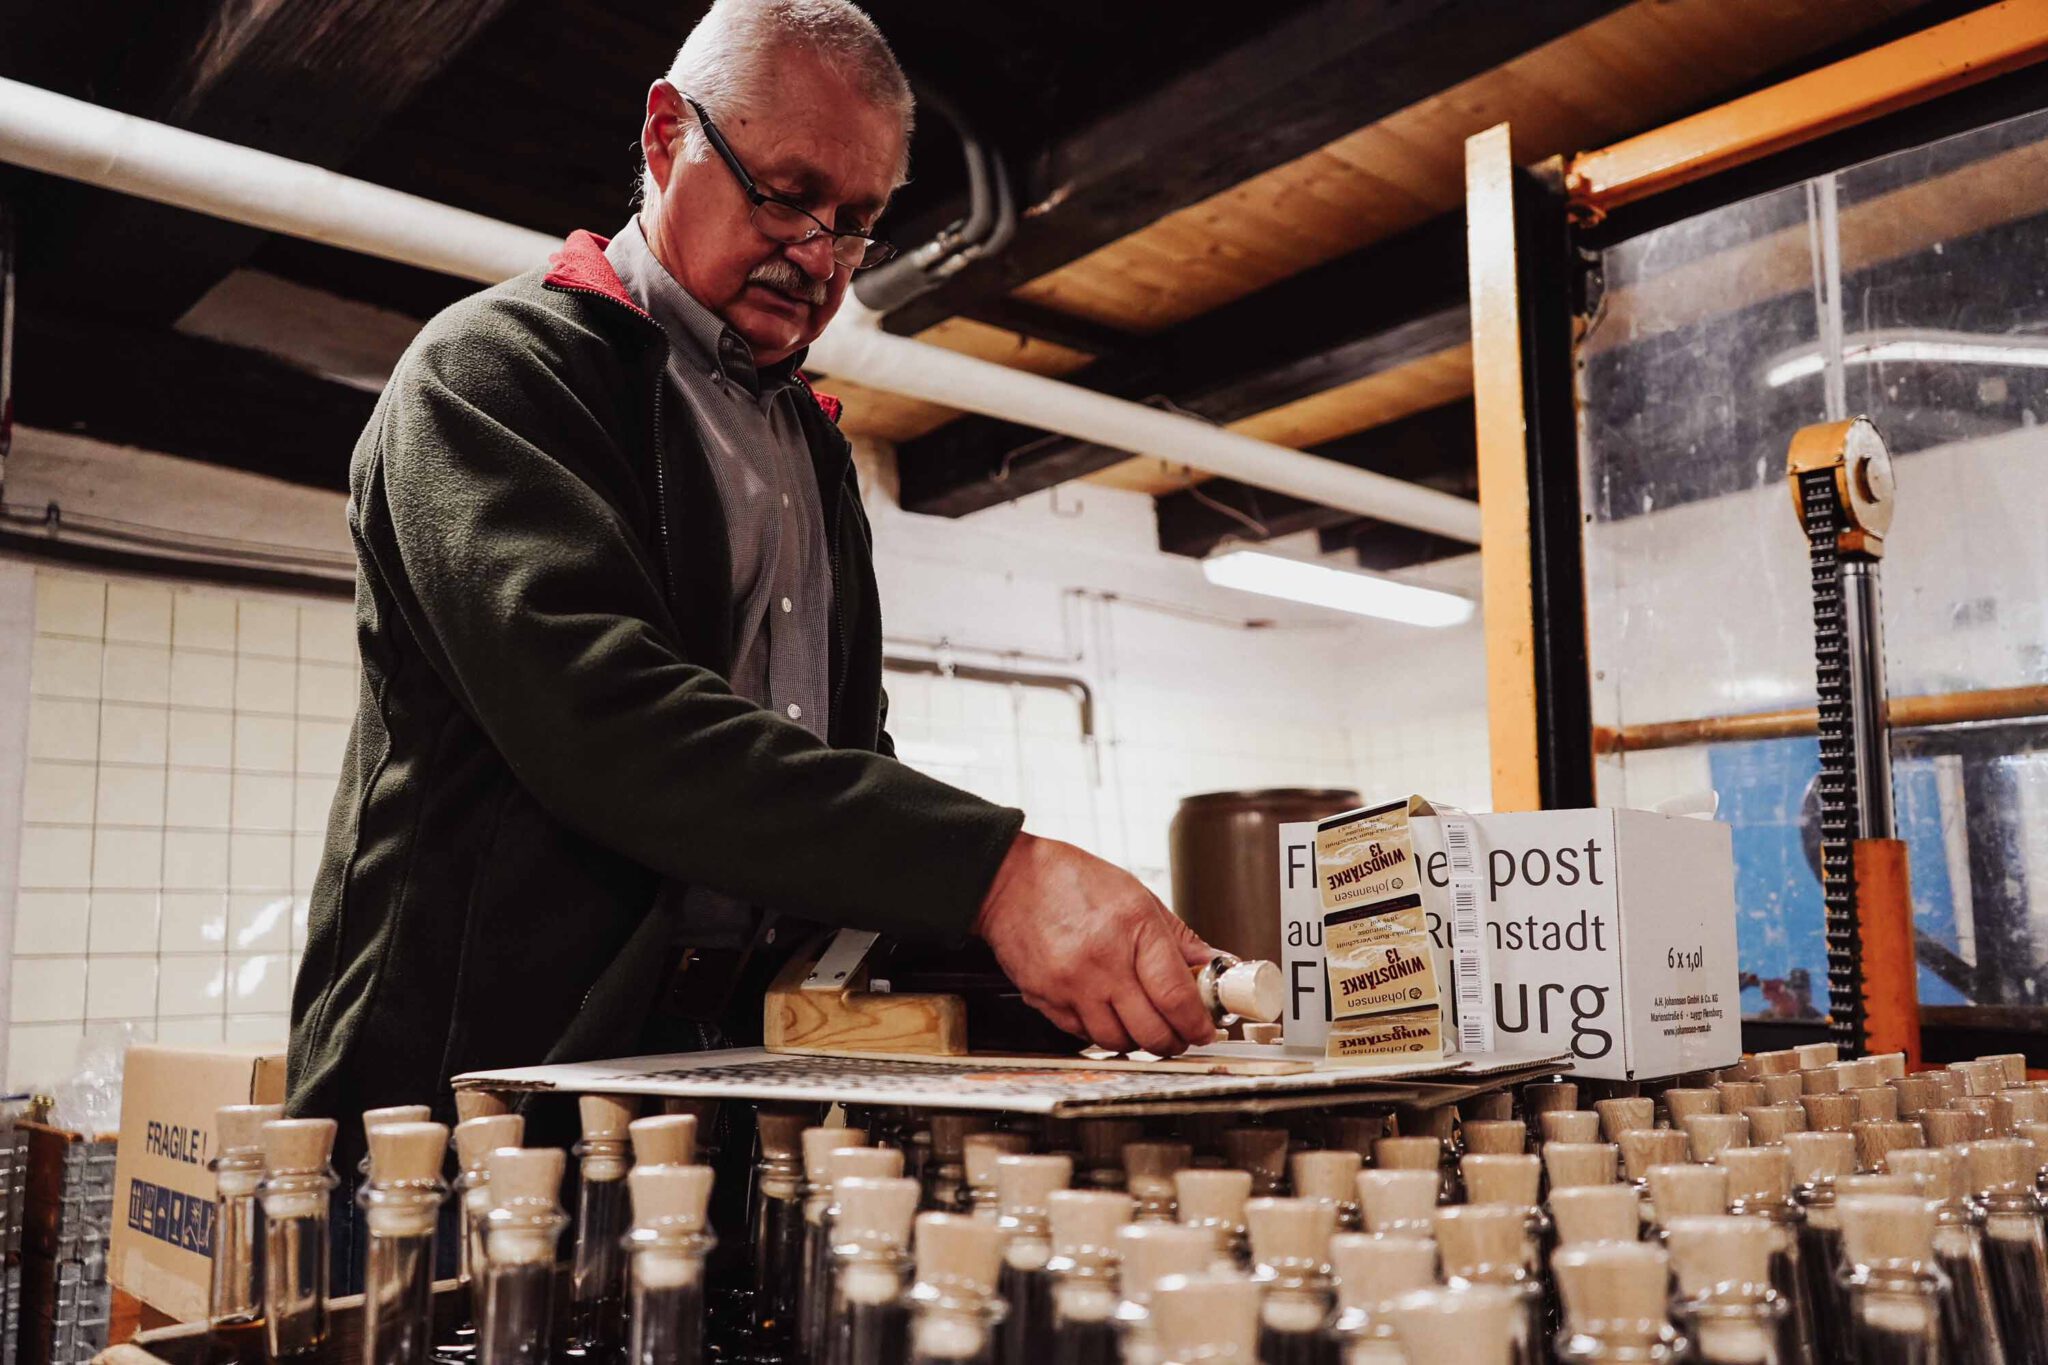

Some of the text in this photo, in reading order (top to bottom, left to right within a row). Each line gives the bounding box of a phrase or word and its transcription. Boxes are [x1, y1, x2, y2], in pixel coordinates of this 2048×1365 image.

[1369, 842, 1384, 858] 13
[1287, 836, 1604, 902] Flepost
[1326, 848, 1406, 891] WINDSTÄRKE
[1334, 880, 1389, 902] Johannsen
[1287, 920, 1322, 947] au
[1385, 948, 1402, 965] 13
[1668, 947, 1675, 968] 6
[1677, 952, 1684, 968] x
[1340, 956, 1426, 996] WINDSTÄRKE
[1291, 957, 1612, 1060] Flurg
[1347, 988, 1407, 1008] Johannsen
[1338, 1027, 1431, 1049] WINDSTÄRKE
[1392, 1025, 1408, 1033] 13
[1342, 1043, 1407, 1056] Johannsen
